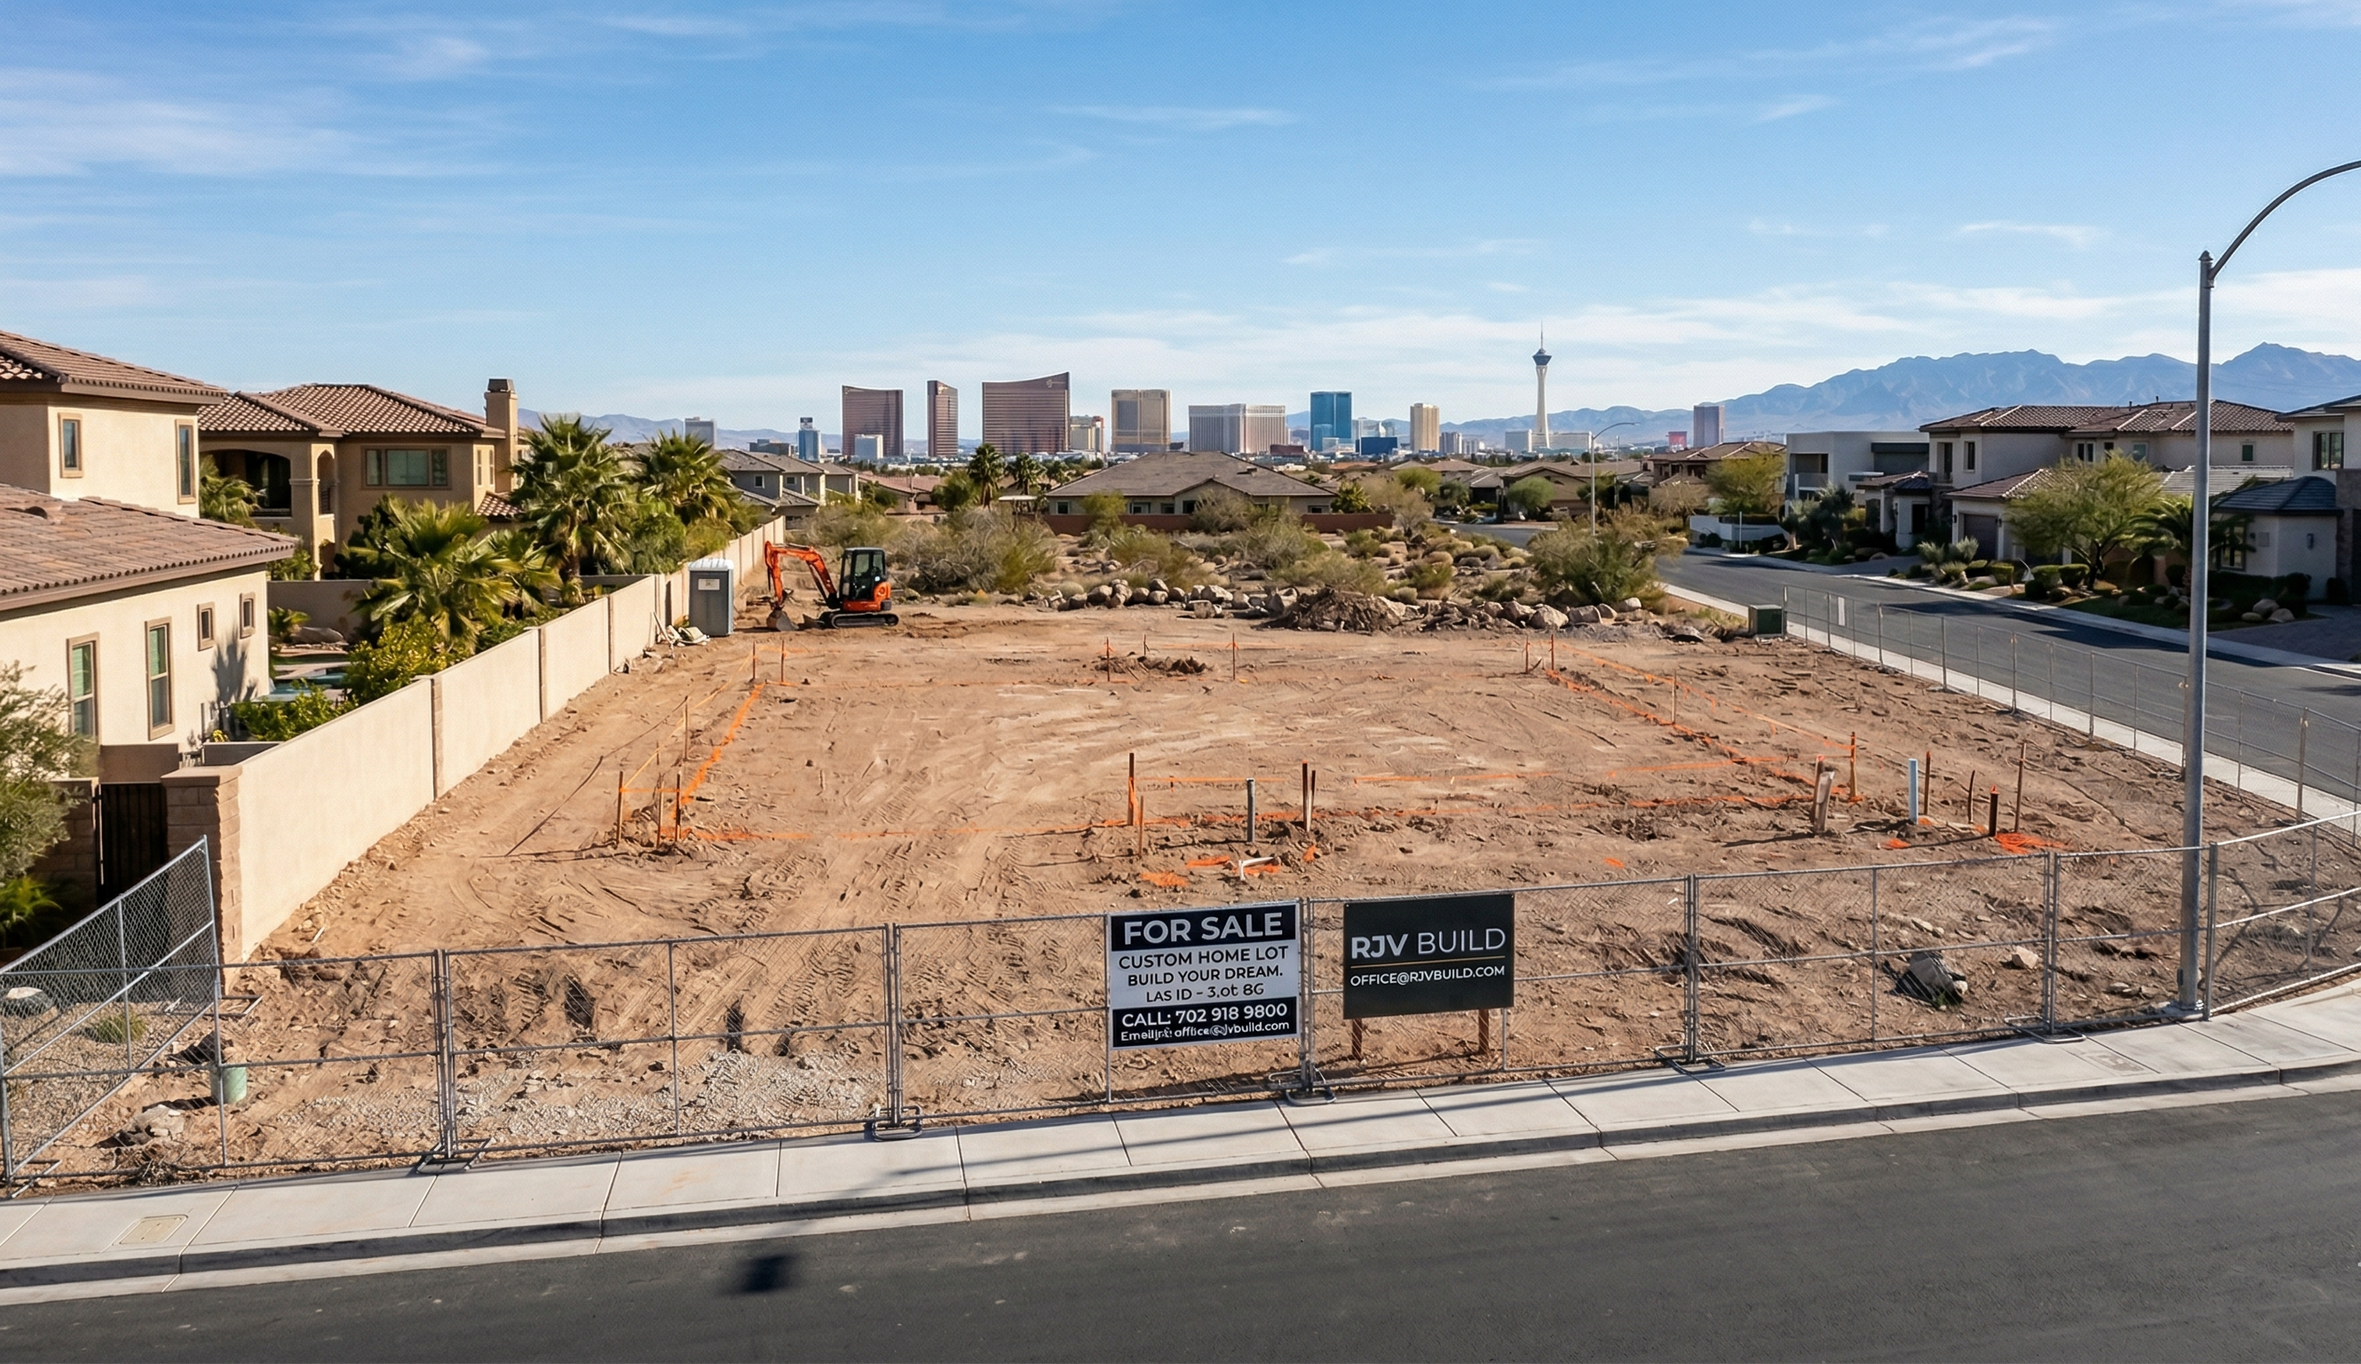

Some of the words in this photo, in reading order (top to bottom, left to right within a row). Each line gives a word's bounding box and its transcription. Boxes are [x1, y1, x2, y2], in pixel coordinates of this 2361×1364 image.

[1124, 919, 1191, 945] FOR
[1201, 912, 1283, 940] SALE
[1351, 933, 1408, 959] RJV
[1417, 928, 1506, 955] BUILD
[1119, 952, 1192, 969] CUSTOM
[1199, 949, 1250, 964] HOME
[1256, 946, 1288, 960] LOT
[1128, 972, 1174, 986] BUILD
[1178, 969, 1220, 983] YOUR
[1225, 965, 1283, 979] DREAM.
[1350, 965, 1505, 987] OFFICE@RJVBUILD.COM
[1146, 990, 1172, 1002] LAS
[1176, 988, 1192, 1000] ID
[1122, 1012, 1171, 1028] CALL:
[1175, 1009, 1207, 1024] 702
[1212, 1007, 1239, 1021] 918
[1243, 1003, 1287, 1019] 9800
